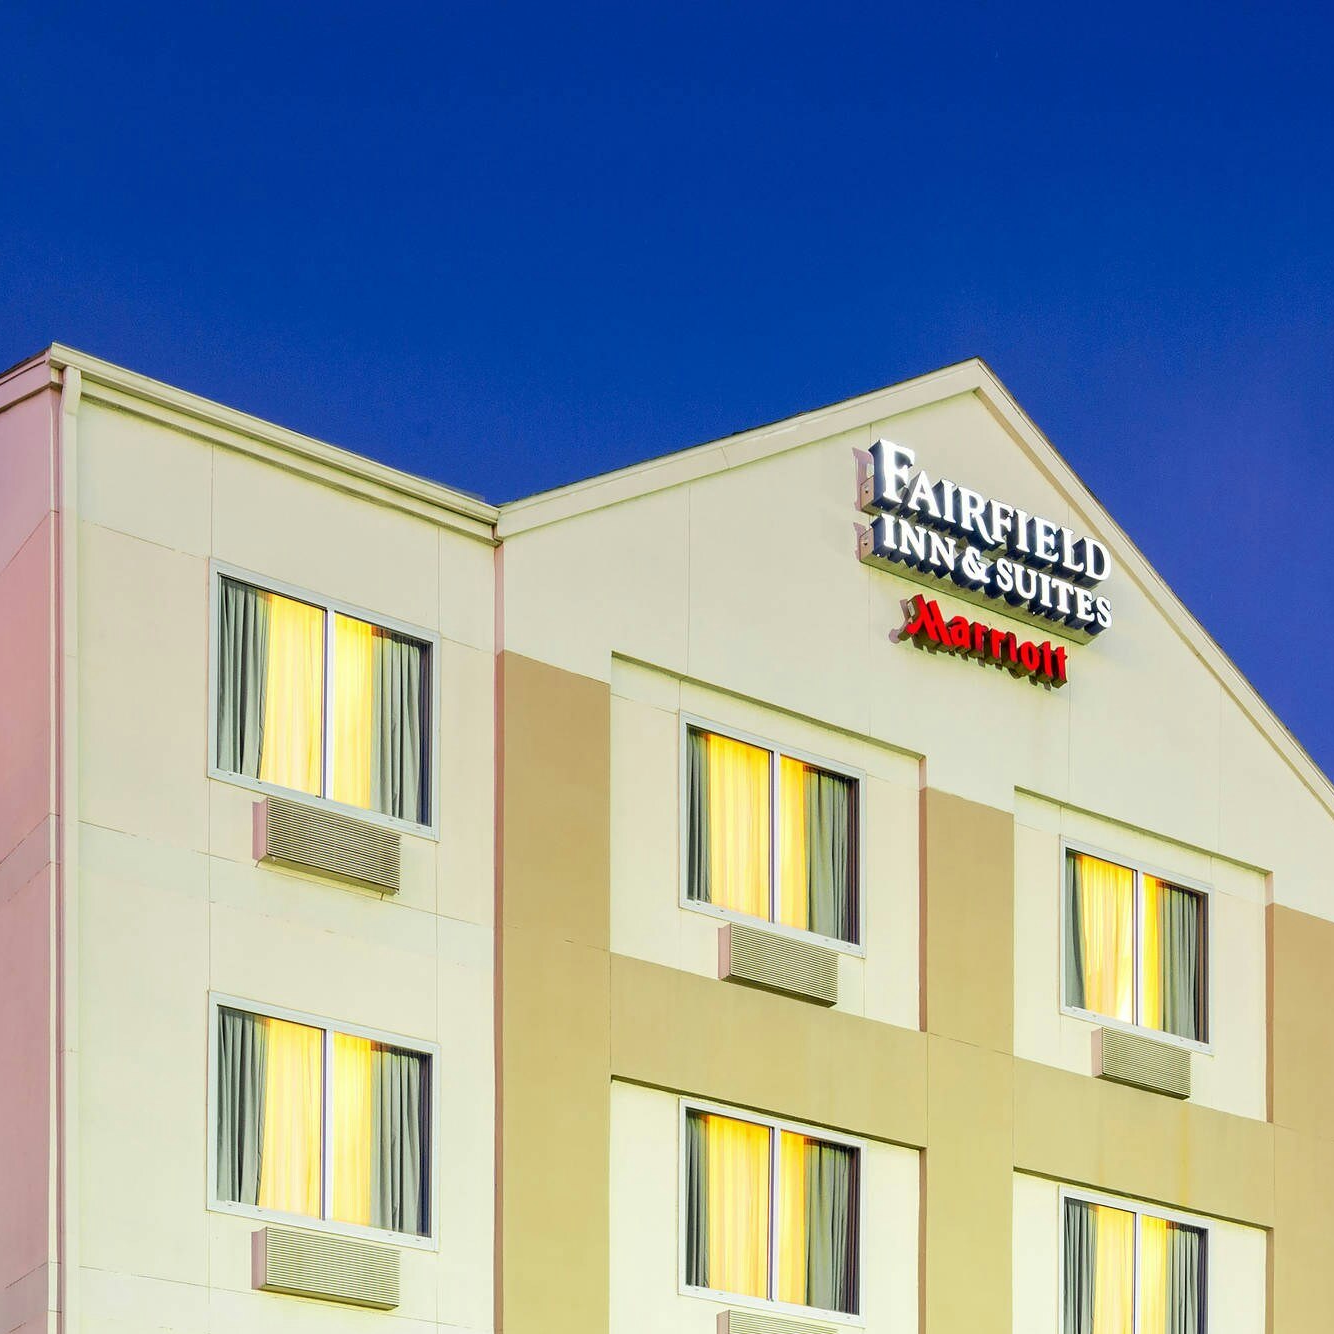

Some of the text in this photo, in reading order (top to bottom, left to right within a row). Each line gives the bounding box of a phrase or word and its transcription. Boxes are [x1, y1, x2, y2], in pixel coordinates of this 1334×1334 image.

[875, 438, 1113, 582] FAIRFIELD
[880, 512, 1113, 629] INN & SUITES
[905, 593, 1068, 683] Marriott
